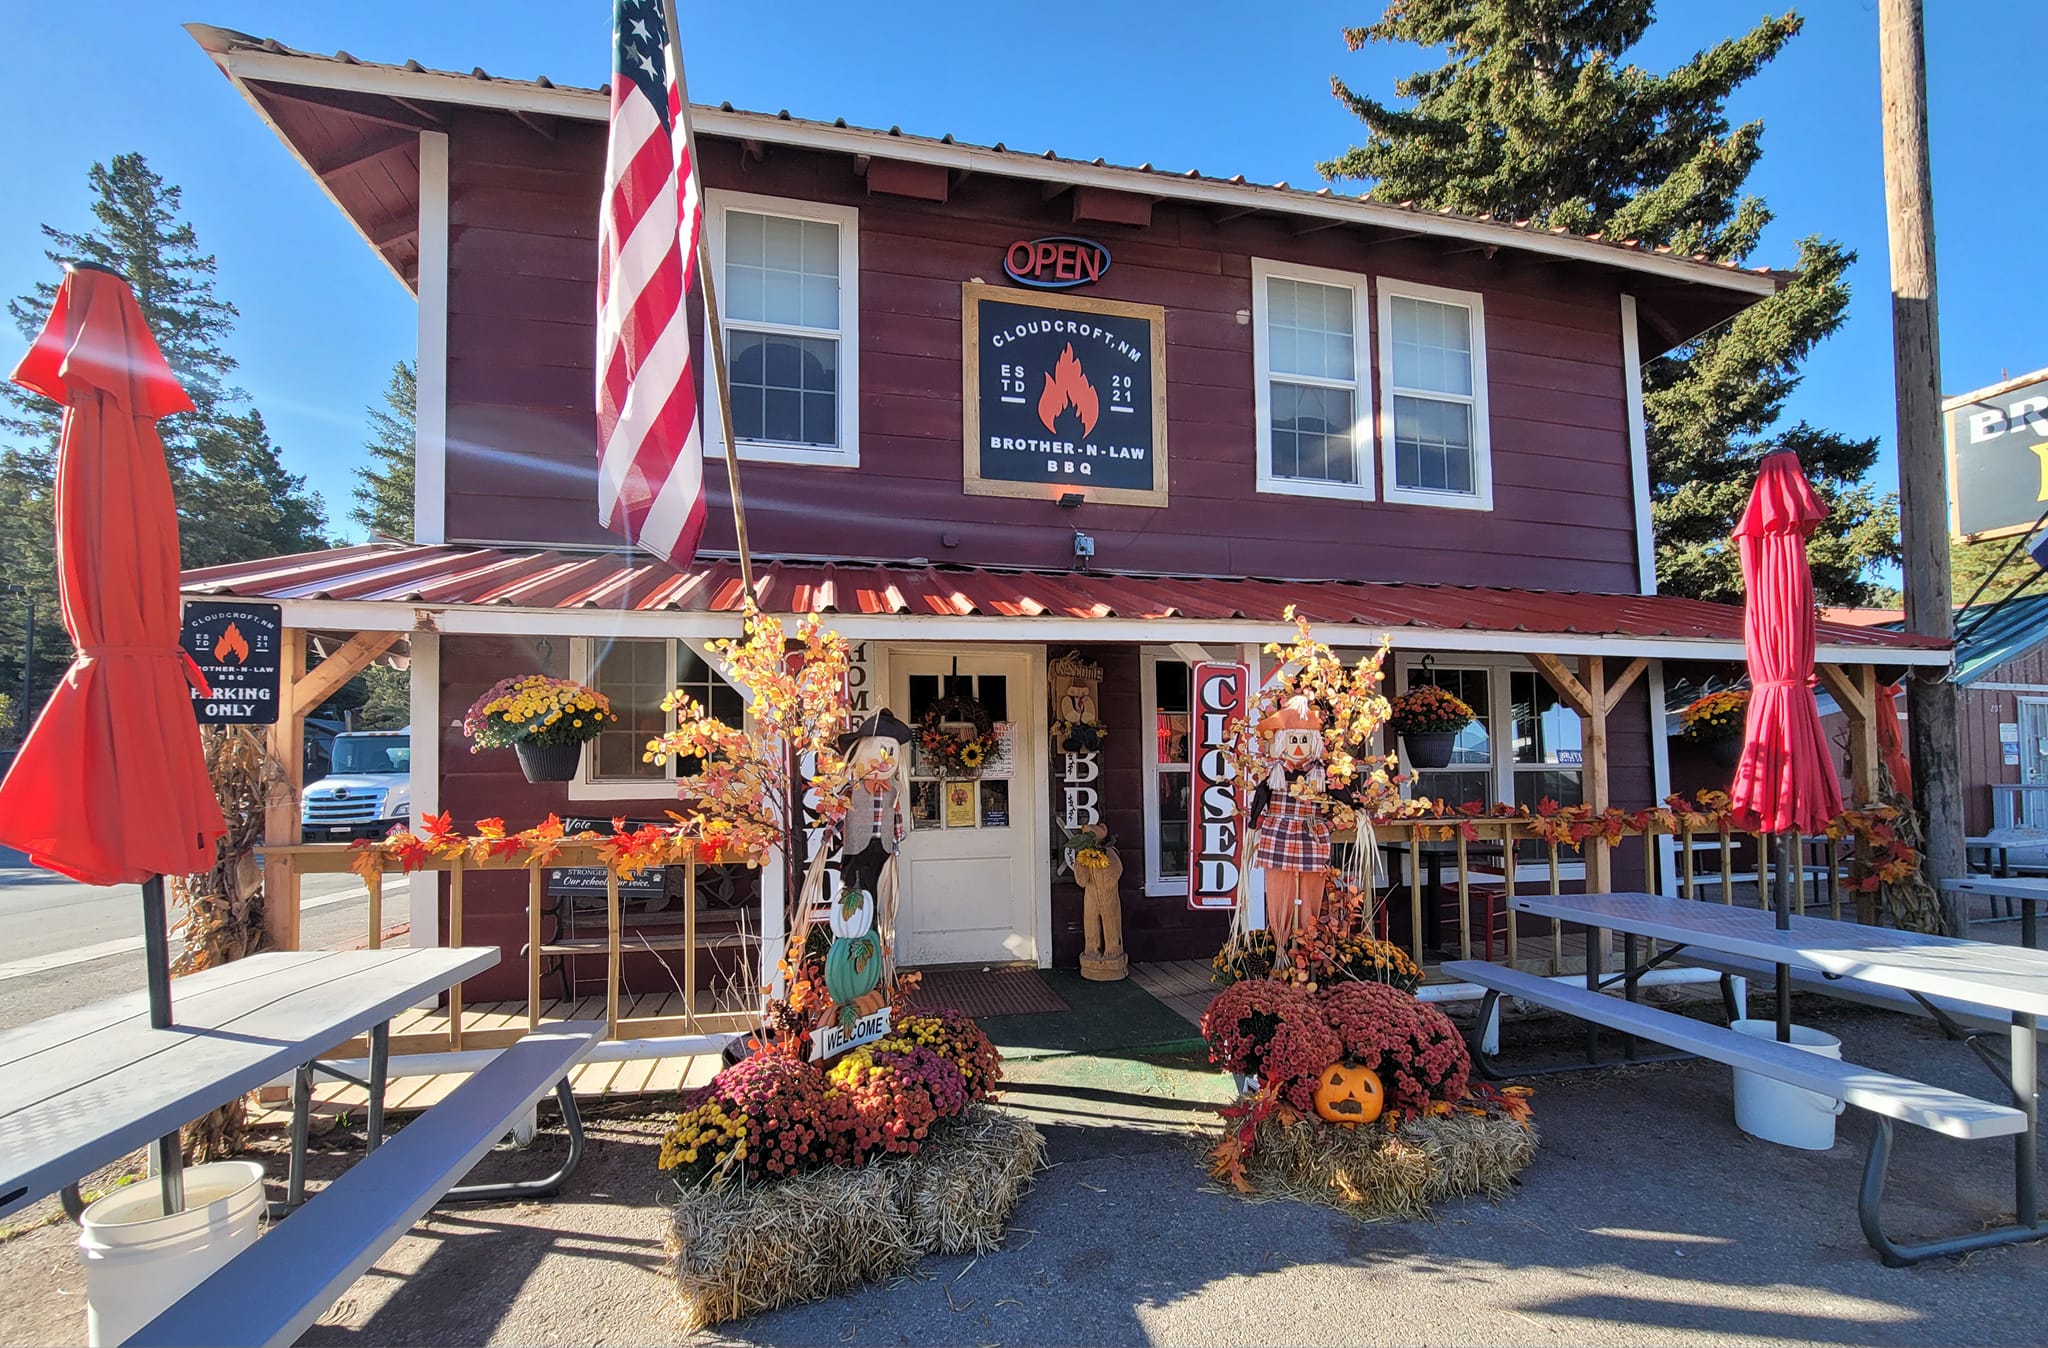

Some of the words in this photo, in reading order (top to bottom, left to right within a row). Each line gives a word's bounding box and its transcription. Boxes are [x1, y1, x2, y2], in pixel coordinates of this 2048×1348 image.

[1006, 240, 1101, 282] OPEN
[1047, 460, 1093, 476] BBQ
[205, 704, 255, 717] ONLY
[1196, 674, 1240, 896] CLOSED
[564, 817, 591, 833] Vote
[563, 876, 580, 886] Our
